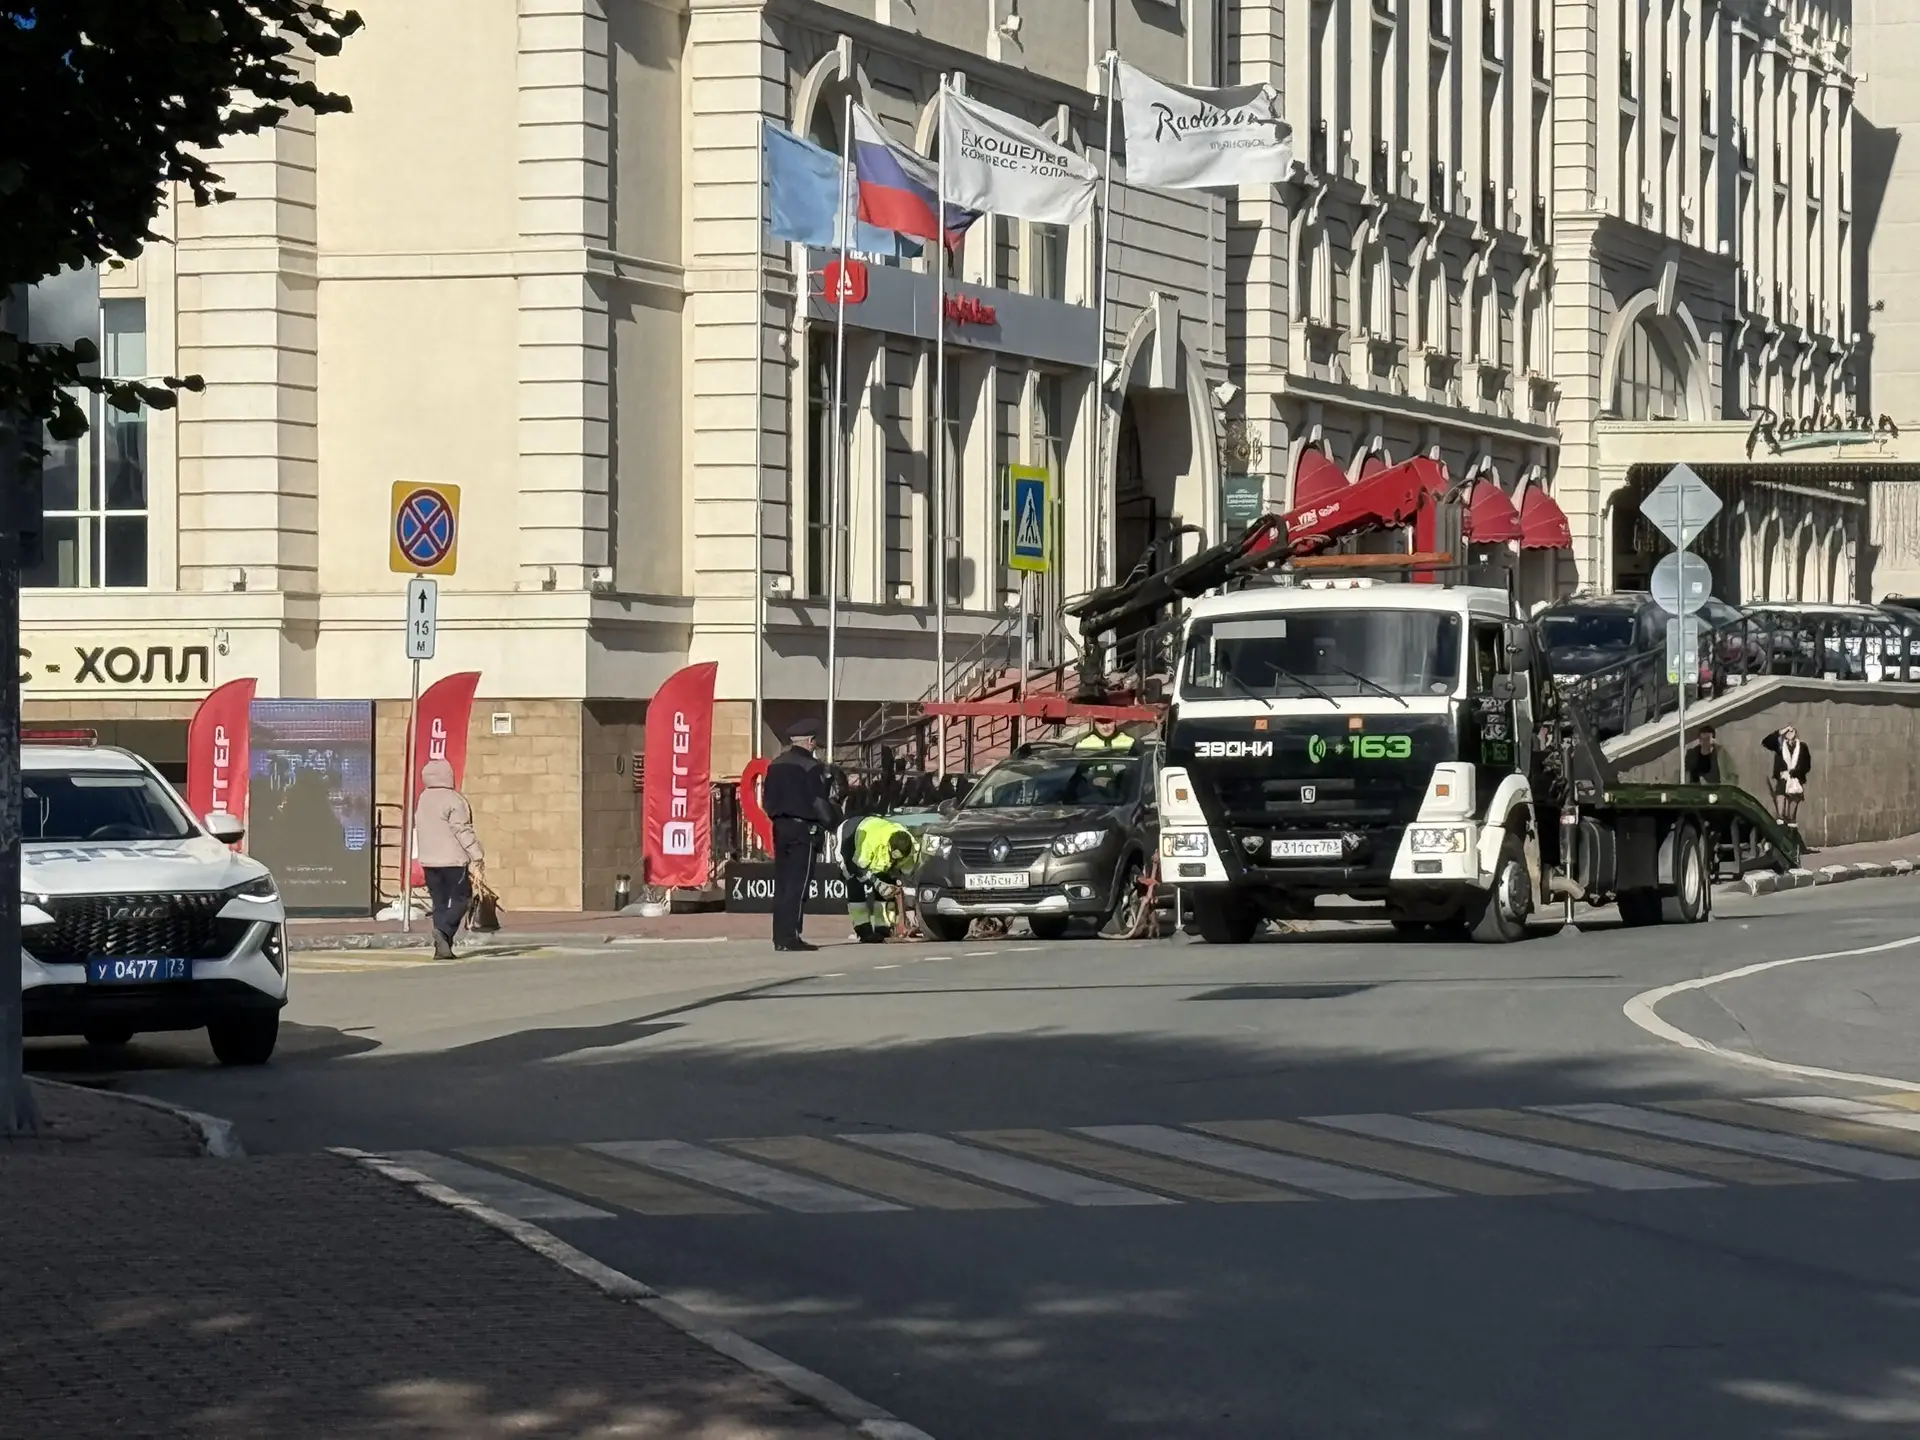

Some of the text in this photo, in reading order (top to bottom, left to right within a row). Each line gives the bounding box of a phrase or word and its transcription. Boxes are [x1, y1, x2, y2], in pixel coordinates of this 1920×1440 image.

[414, 620, 430, 636] 15
[74, 646, 209, 683] ХОЛЛ
[1194, 741, 1273, 757] ЗВОНИ
[213, 725, 229, 814] ГГЕР
[115, 959, 158, 979] 0477
